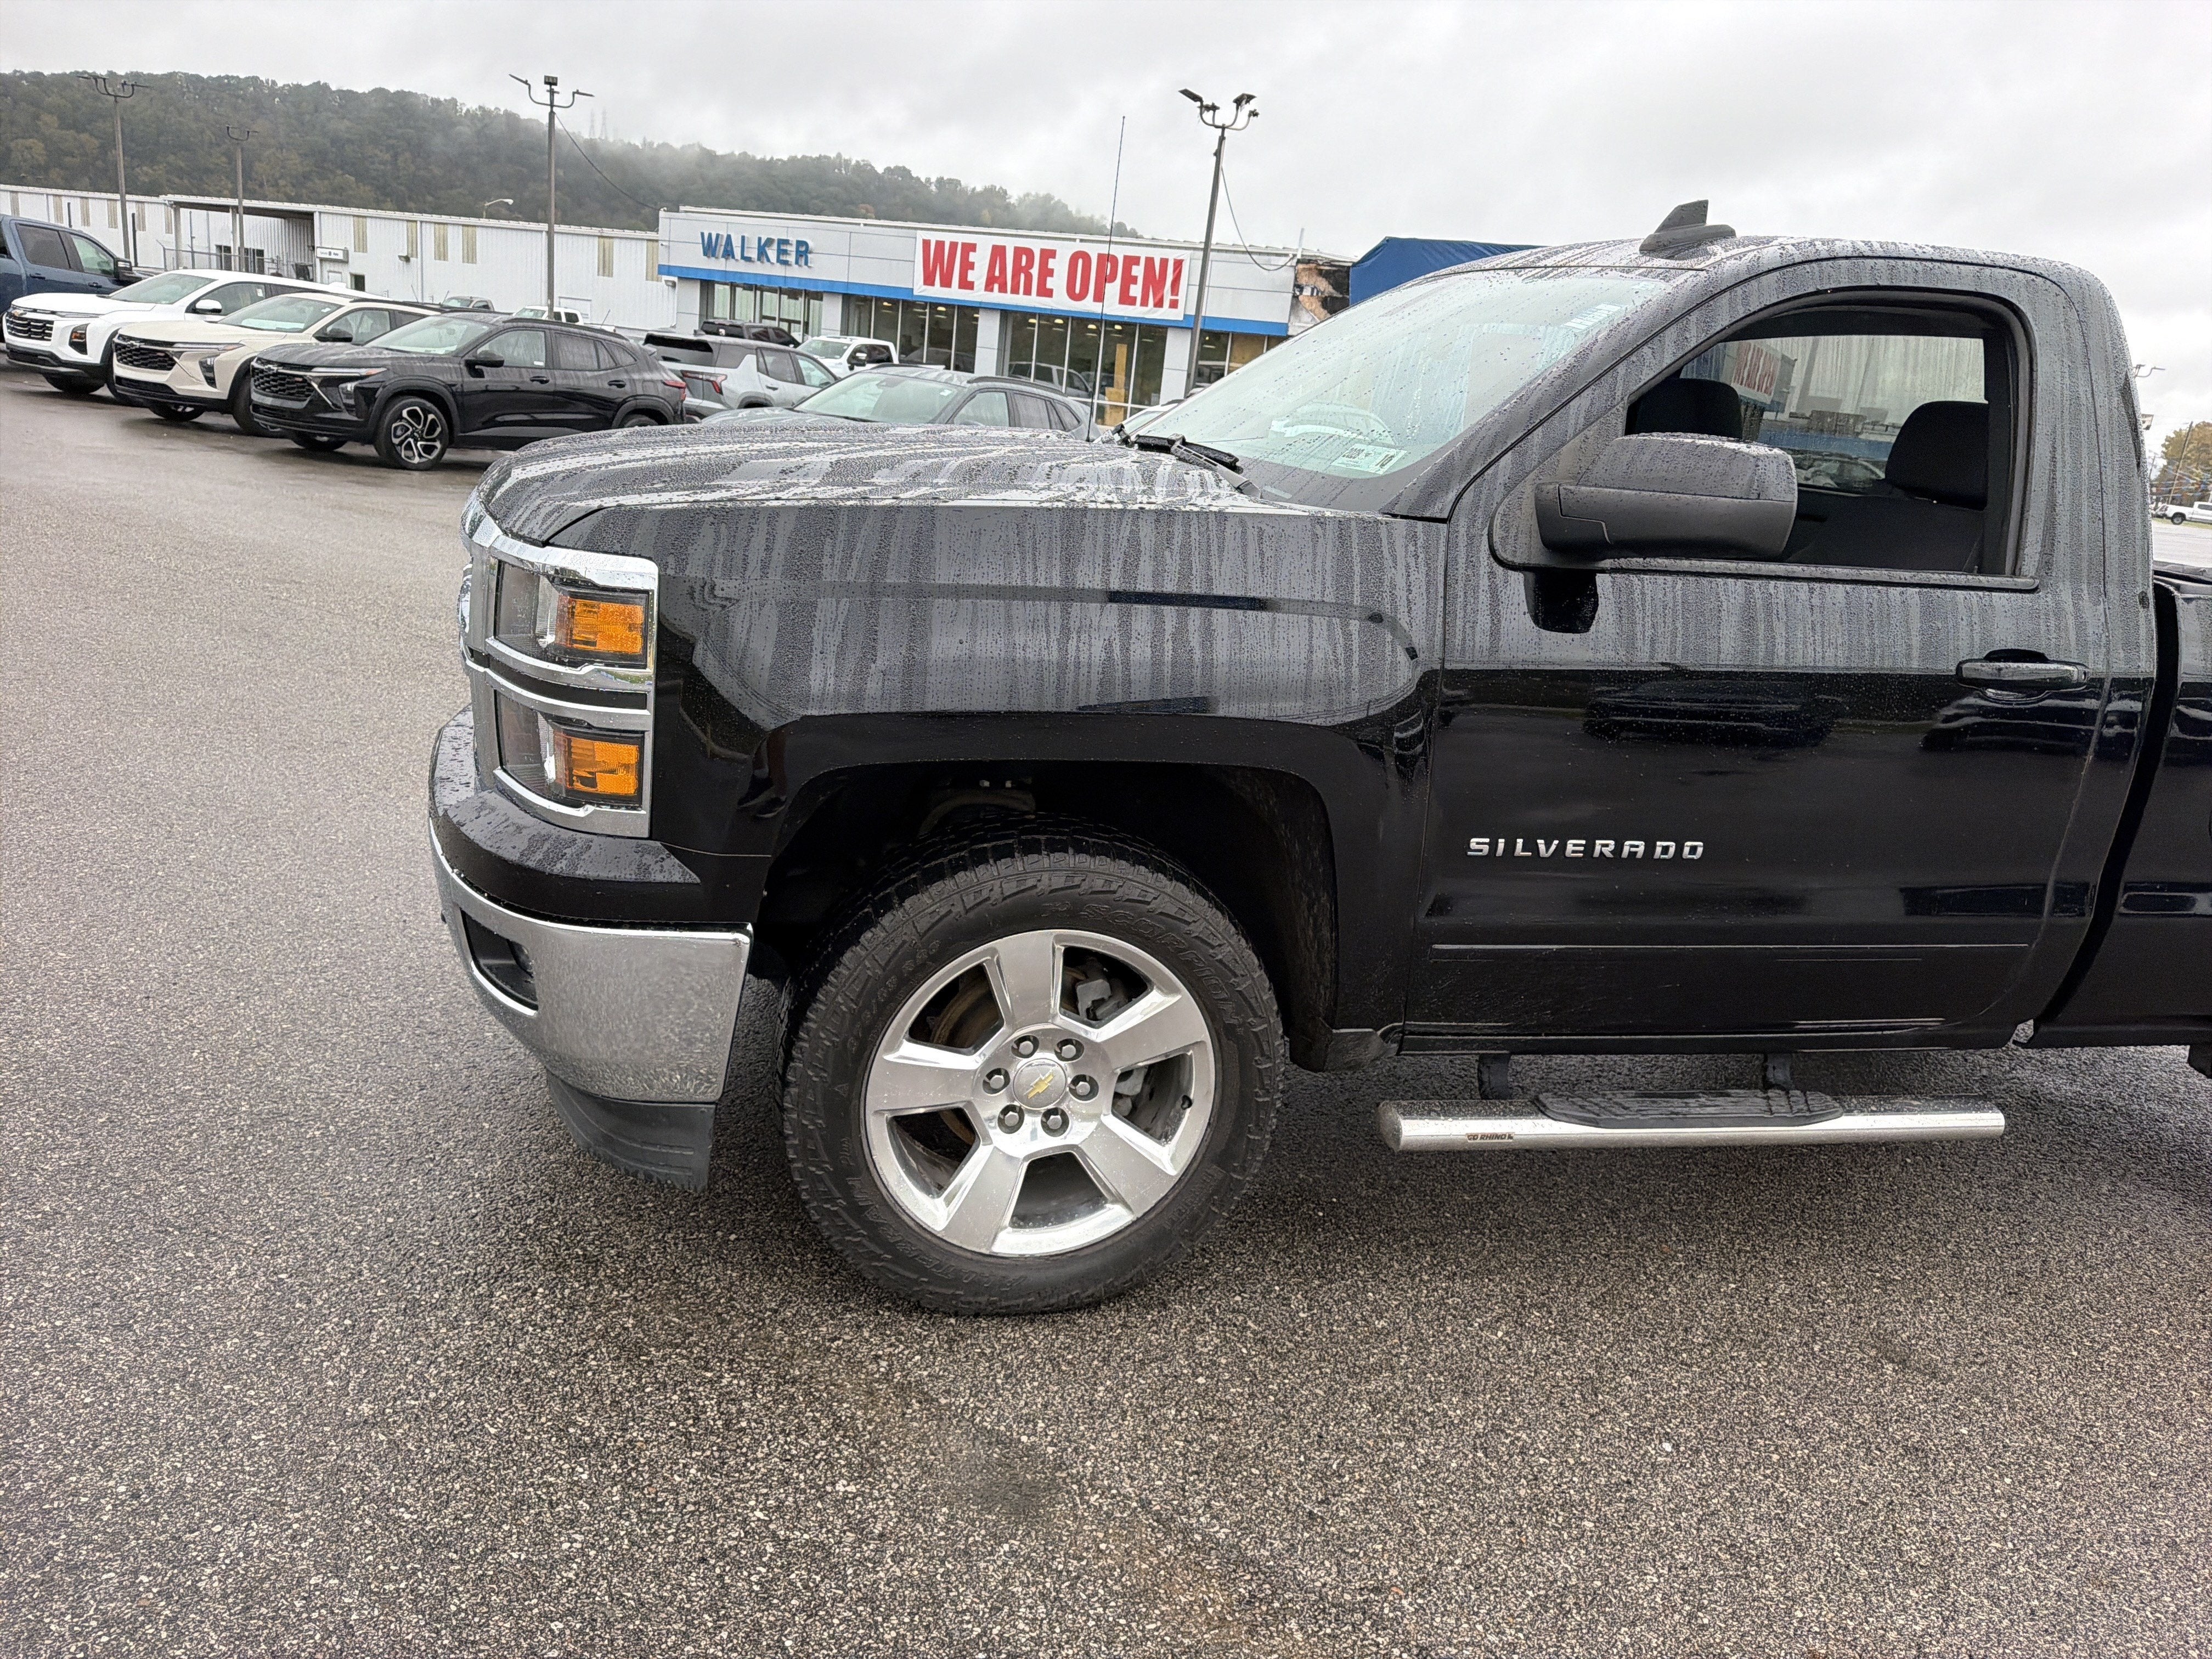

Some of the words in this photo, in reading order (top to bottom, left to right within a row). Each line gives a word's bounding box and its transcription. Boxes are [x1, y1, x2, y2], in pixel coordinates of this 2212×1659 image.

[701, 232, 810, 266] WALKER
[922, 239, 977, 290] WE
[984, 245, 1056, 298] ARE
[1066, 250, 1184, 309] OPEN!
[1467, 838, 1703, 860] SILVERADO
[1080, 902, 1242, 1025] SCORPION
